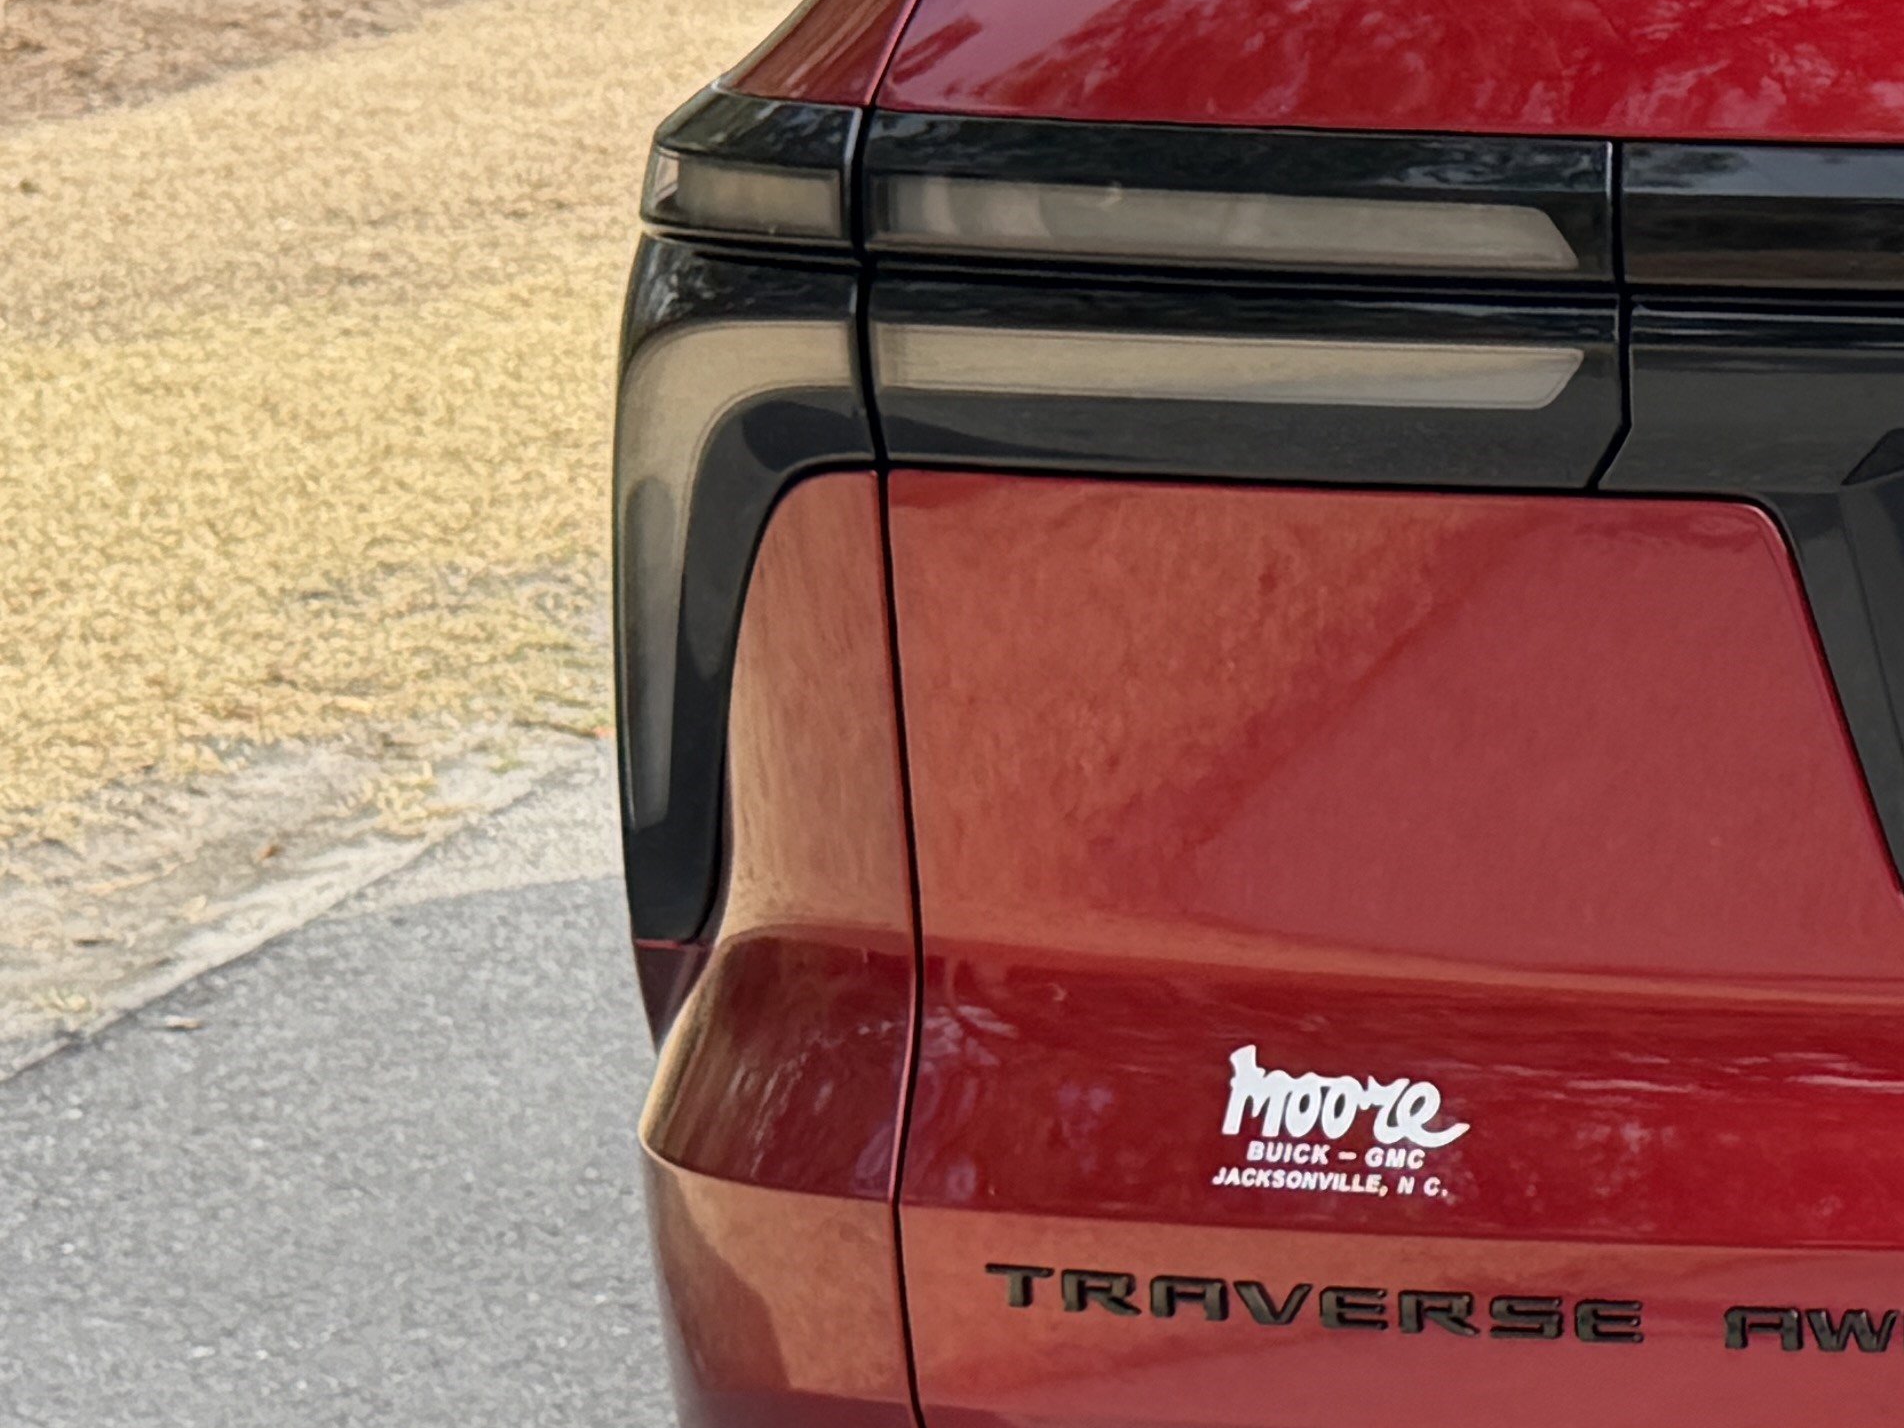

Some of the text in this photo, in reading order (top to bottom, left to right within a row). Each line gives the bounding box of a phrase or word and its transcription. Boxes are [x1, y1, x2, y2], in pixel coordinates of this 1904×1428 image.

[1246, 1140, 1331, 1165] BUICK
[1364, 1146, 1426, 1170] GMC
[1212, 1166, 1389, 1197] JACKSONVILLE,
[984, 1262, 1643, 1344] TRAVERSE
